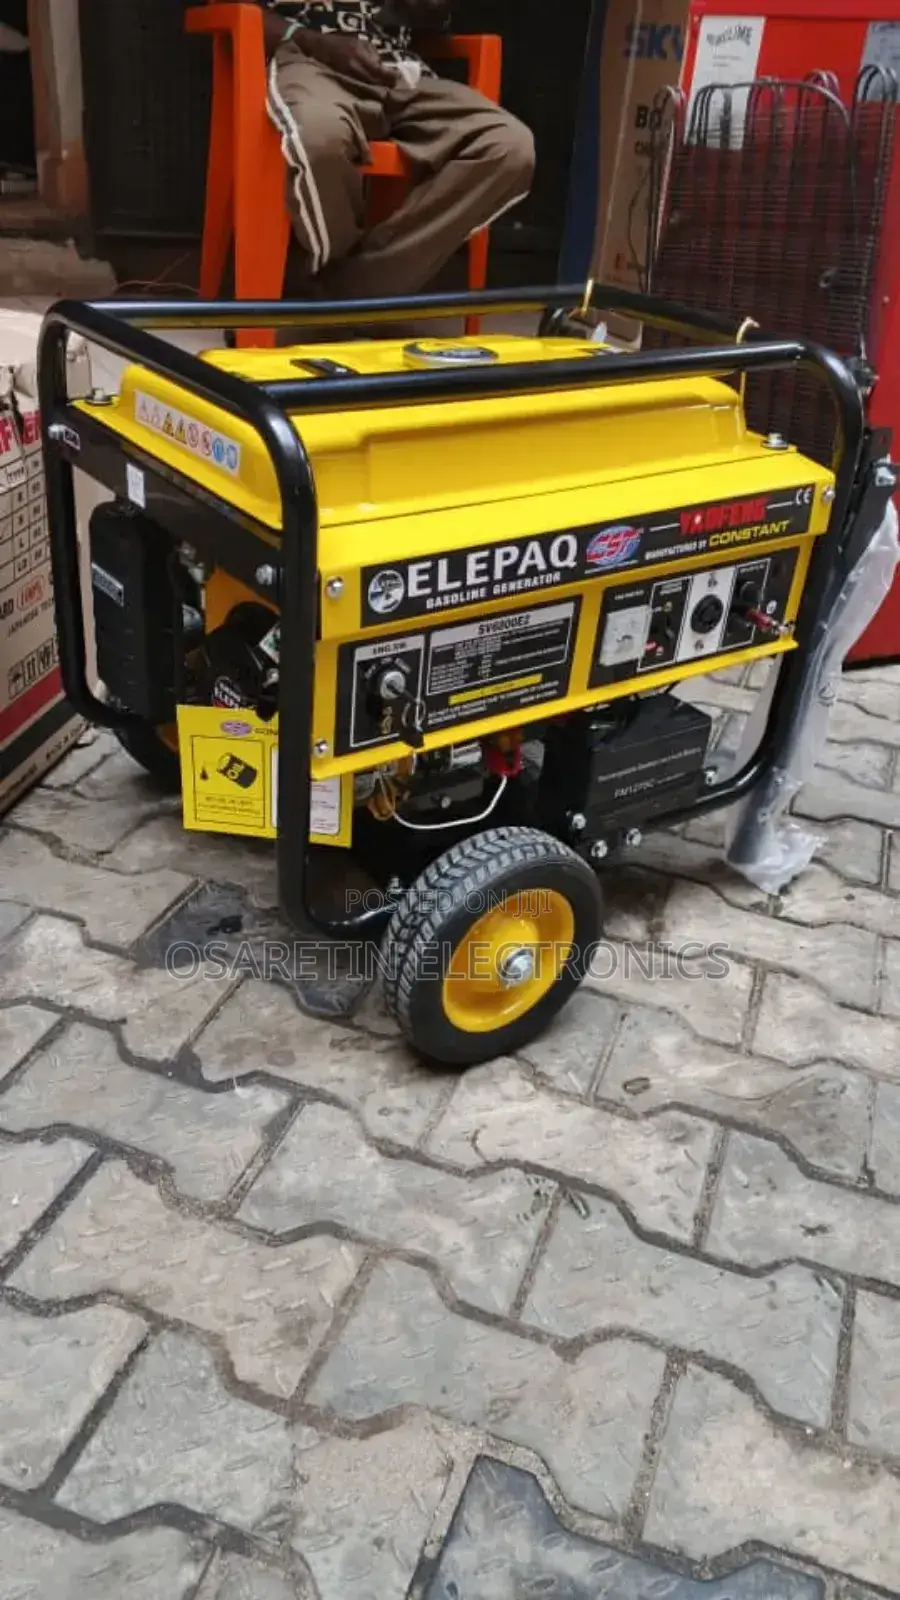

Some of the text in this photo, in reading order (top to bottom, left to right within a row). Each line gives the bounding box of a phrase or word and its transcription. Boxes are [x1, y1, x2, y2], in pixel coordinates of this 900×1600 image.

[708, 519, 790, 547] CONSTANT
[407, 533, 578, 598] ELEPAQ
[426, 571, 562, 610] GASOLINE GENERATOR
